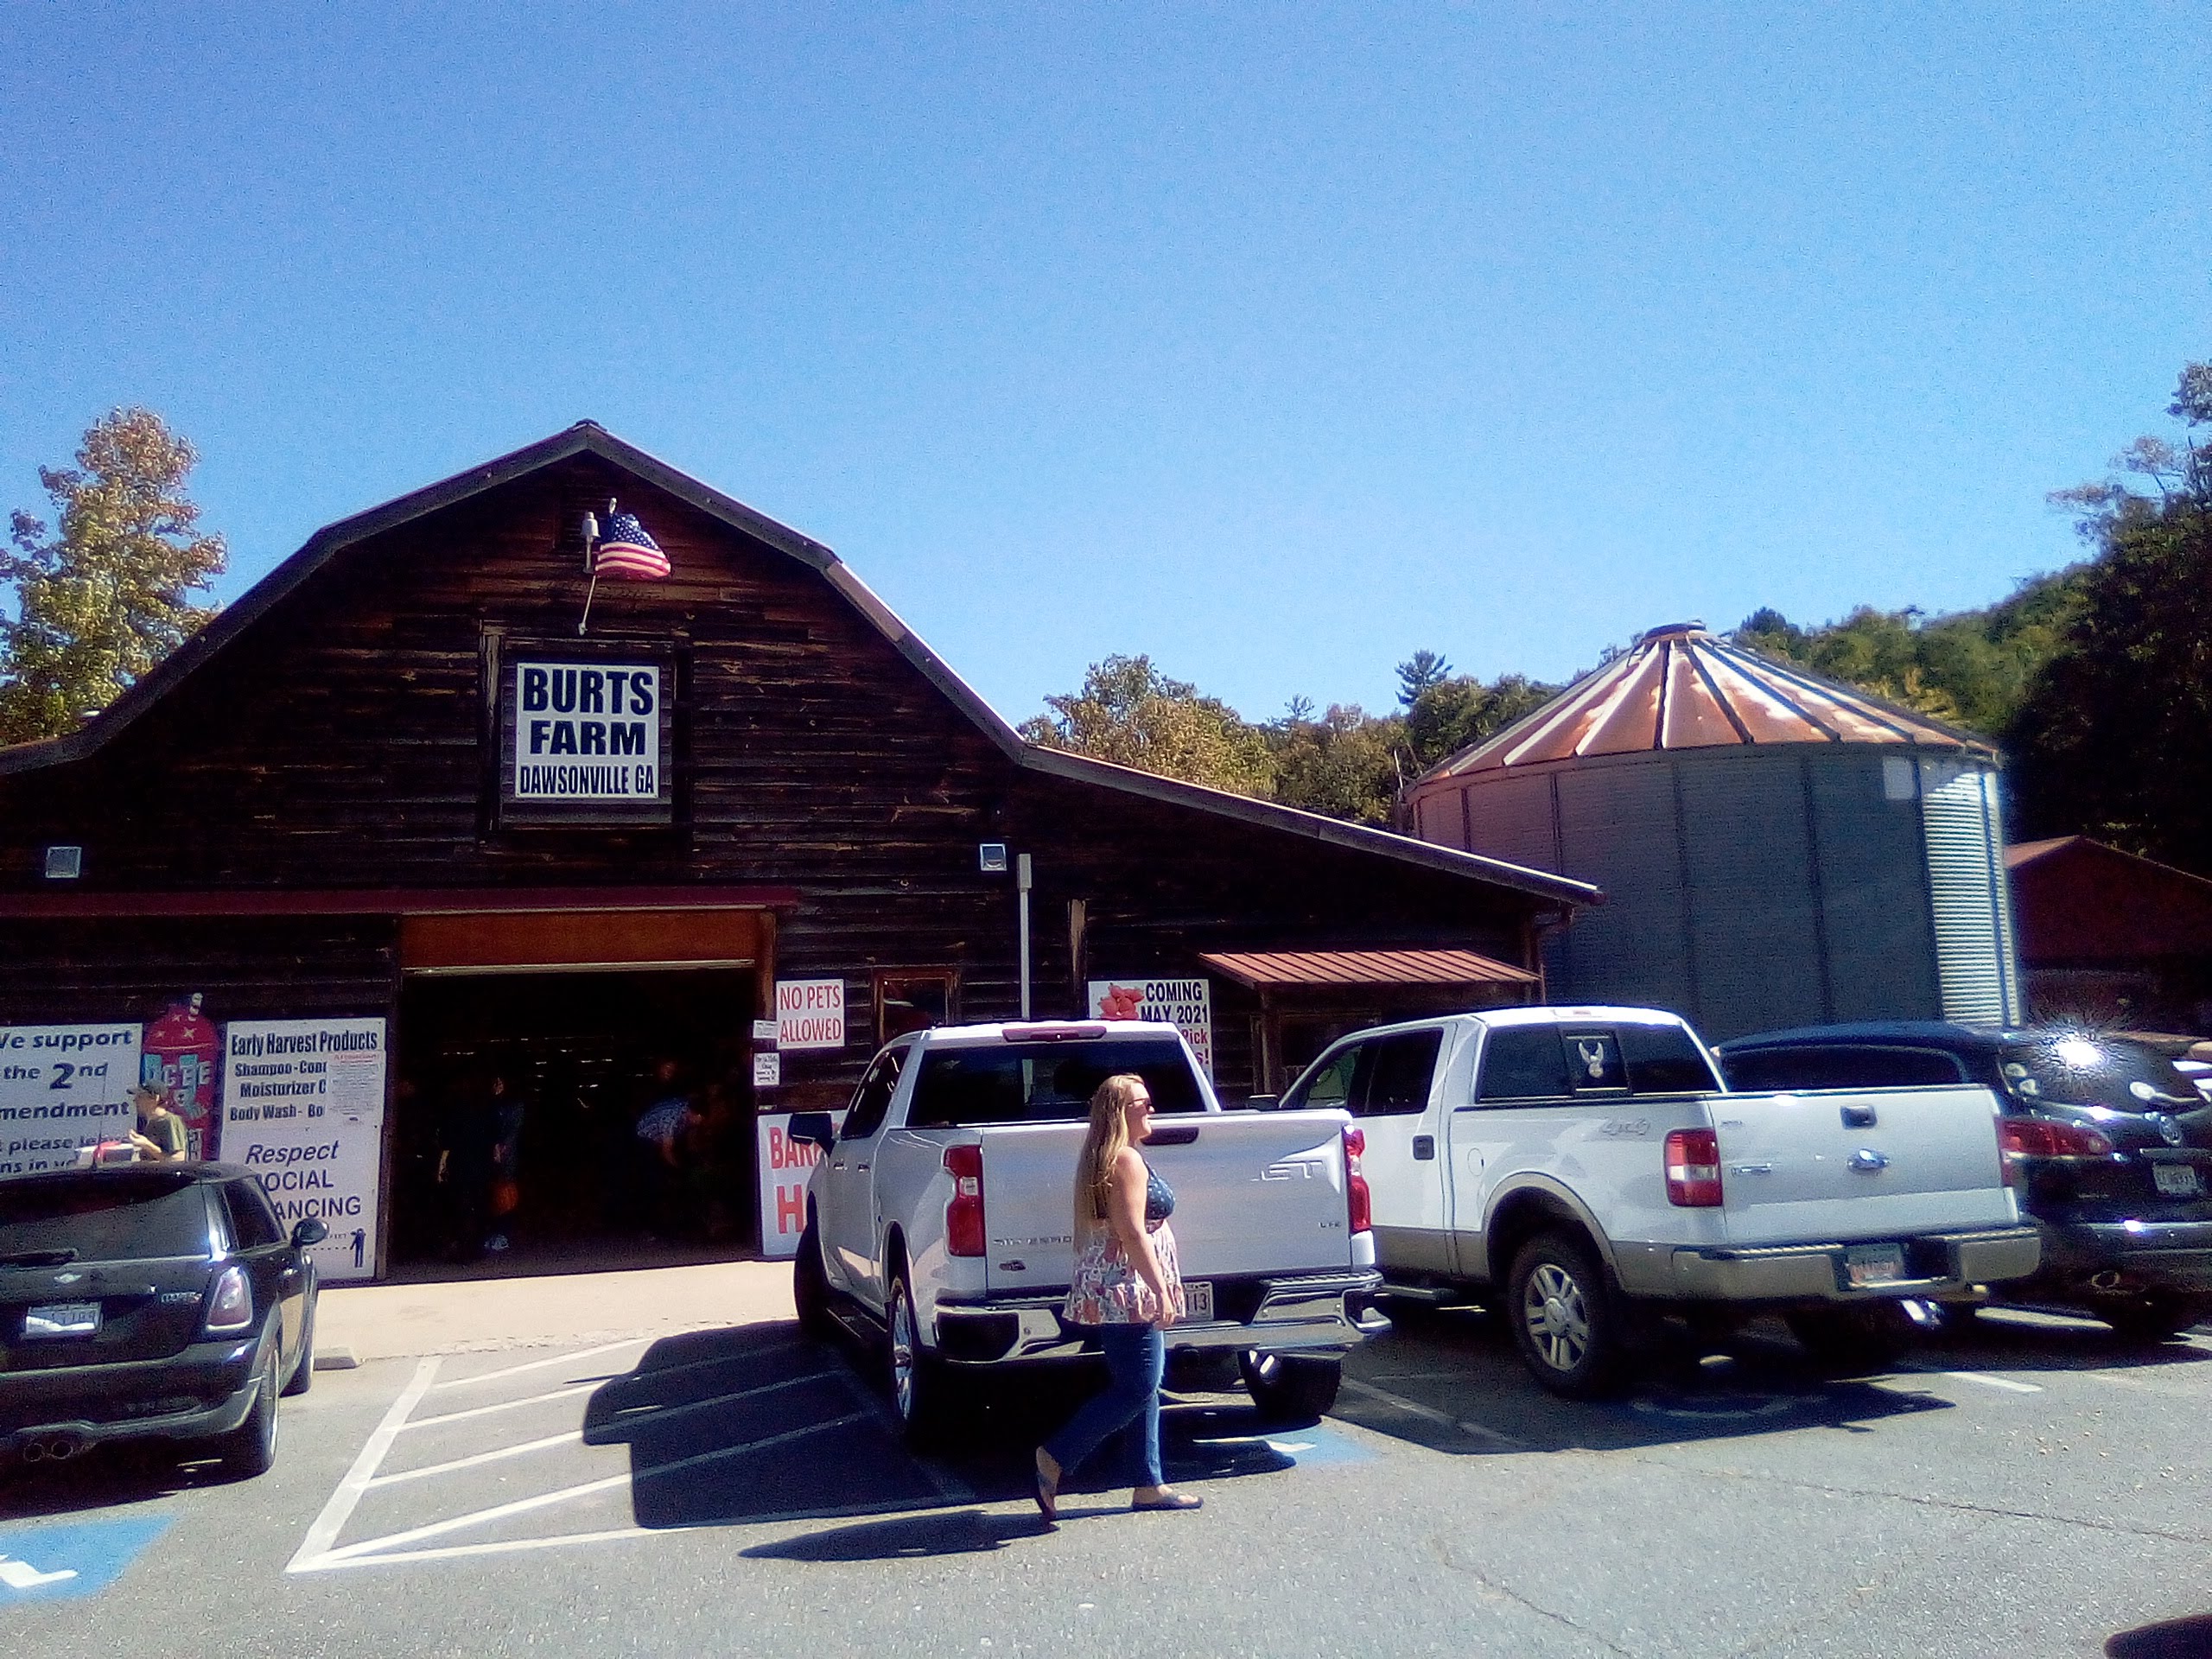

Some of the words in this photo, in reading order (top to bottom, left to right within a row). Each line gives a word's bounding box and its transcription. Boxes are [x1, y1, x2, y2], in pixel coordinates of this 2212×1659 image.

[523, 668, 653, 715] BURTS
[530, 720, 646, 755] FARM
[520, 766, 629, 794] DAWSONVILLE
[635, 765, 654, 793] GA
[779, 987, 802, 1009] NO
[807, 984, 841, 1008] PETS
[1146, 982, 1203, 1001] COMING
[1141, 1005, 1172, 1022] MAY
[1176, 1004, 1208, 1024] 2021
[33, 1030, 132, 1052] support
[779, 1018, 842, 1042] ALLOWED
[232, 1034, 264, 1057] Early
[267, 1033, 318, 1054] Harvest
[320, 1030, 378, 1052] Products
[3, 1065, 41, 1080] the
[49, 1062, 108, 1090] 2nd
[235, 1062, 292, 1077] Shampoo
[240, 1081, 316, 1098] Moisturizer
[230, 1106, 260, 1122] Body
[10, 1138, 73, 1156] please
[245, 1140, 340, 1167] Respect
[264, 1169, 334, 1192] OCIAL
